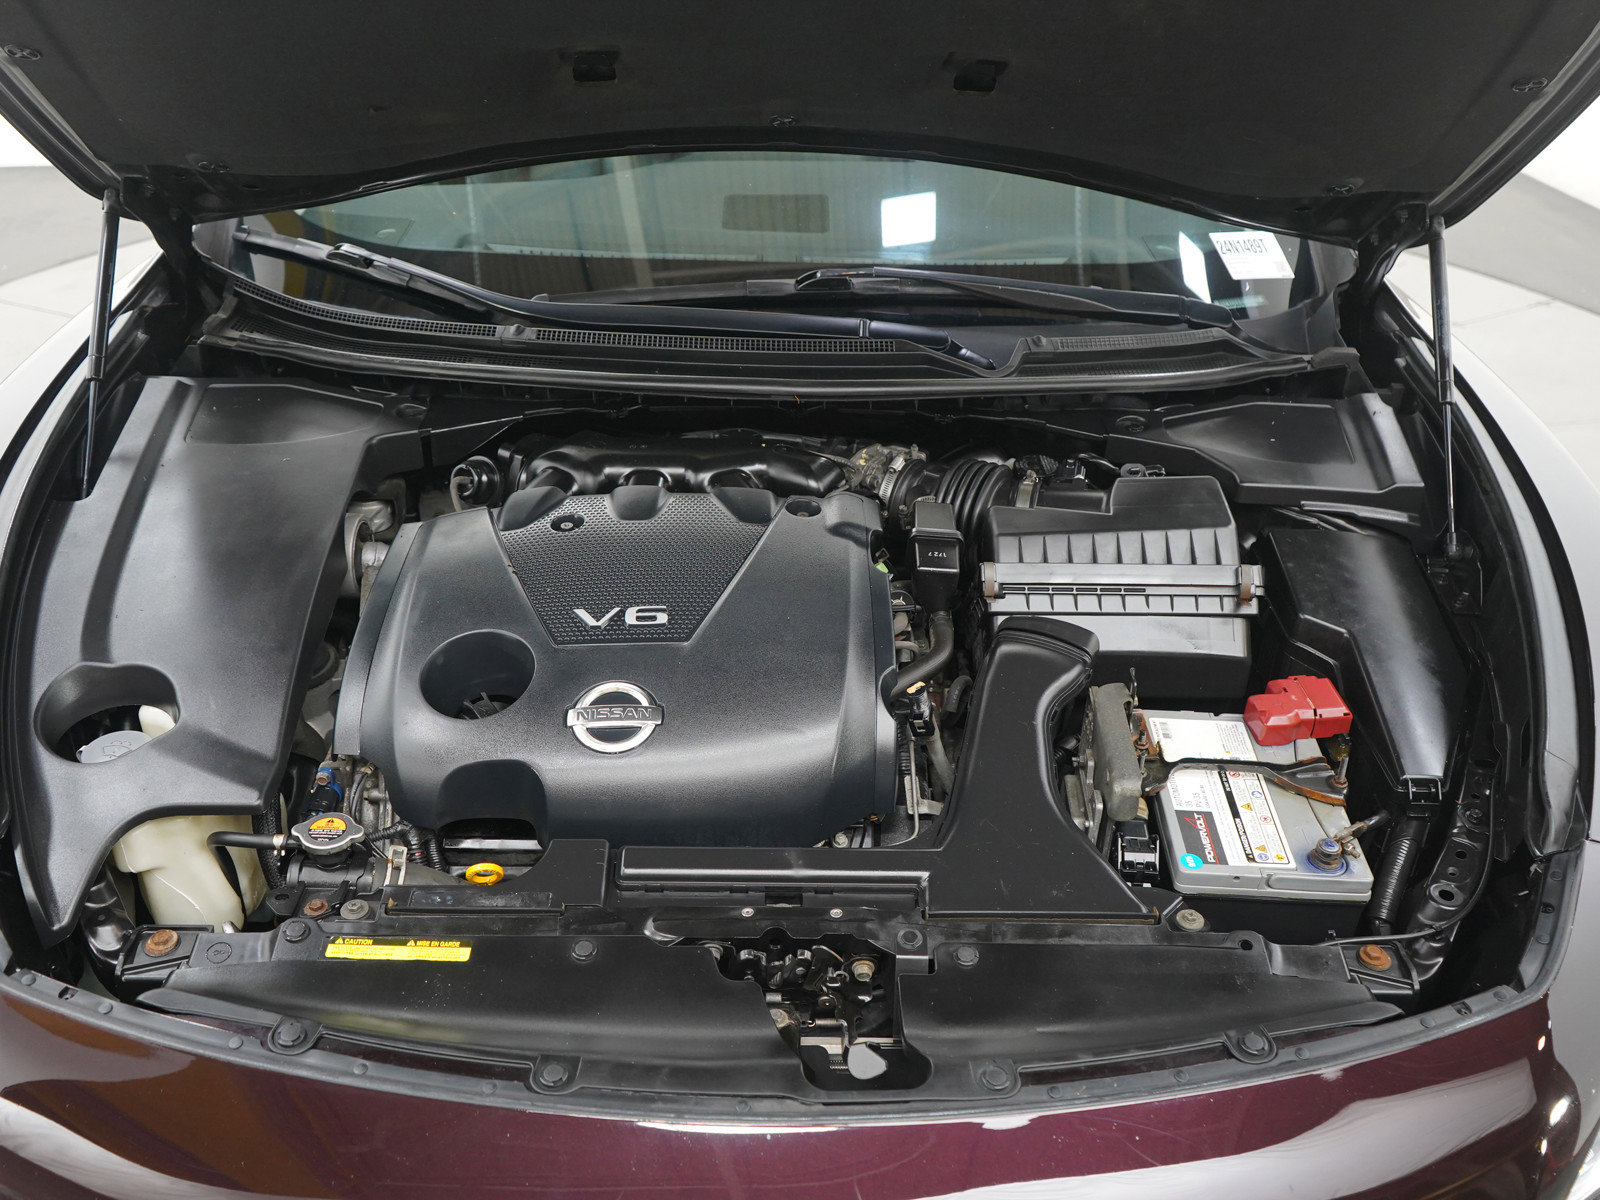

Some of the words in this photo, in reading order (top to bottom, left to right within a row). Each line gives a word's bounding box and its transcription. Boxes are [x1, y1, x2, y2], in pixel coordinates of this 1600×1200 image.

[573, 605, 669, 629] V6
[576, 707, 652, 722] NISSAN
[1193, 811, 1217, 863] POWERVOLT
[344, 938, 373, 946] CAUTION
